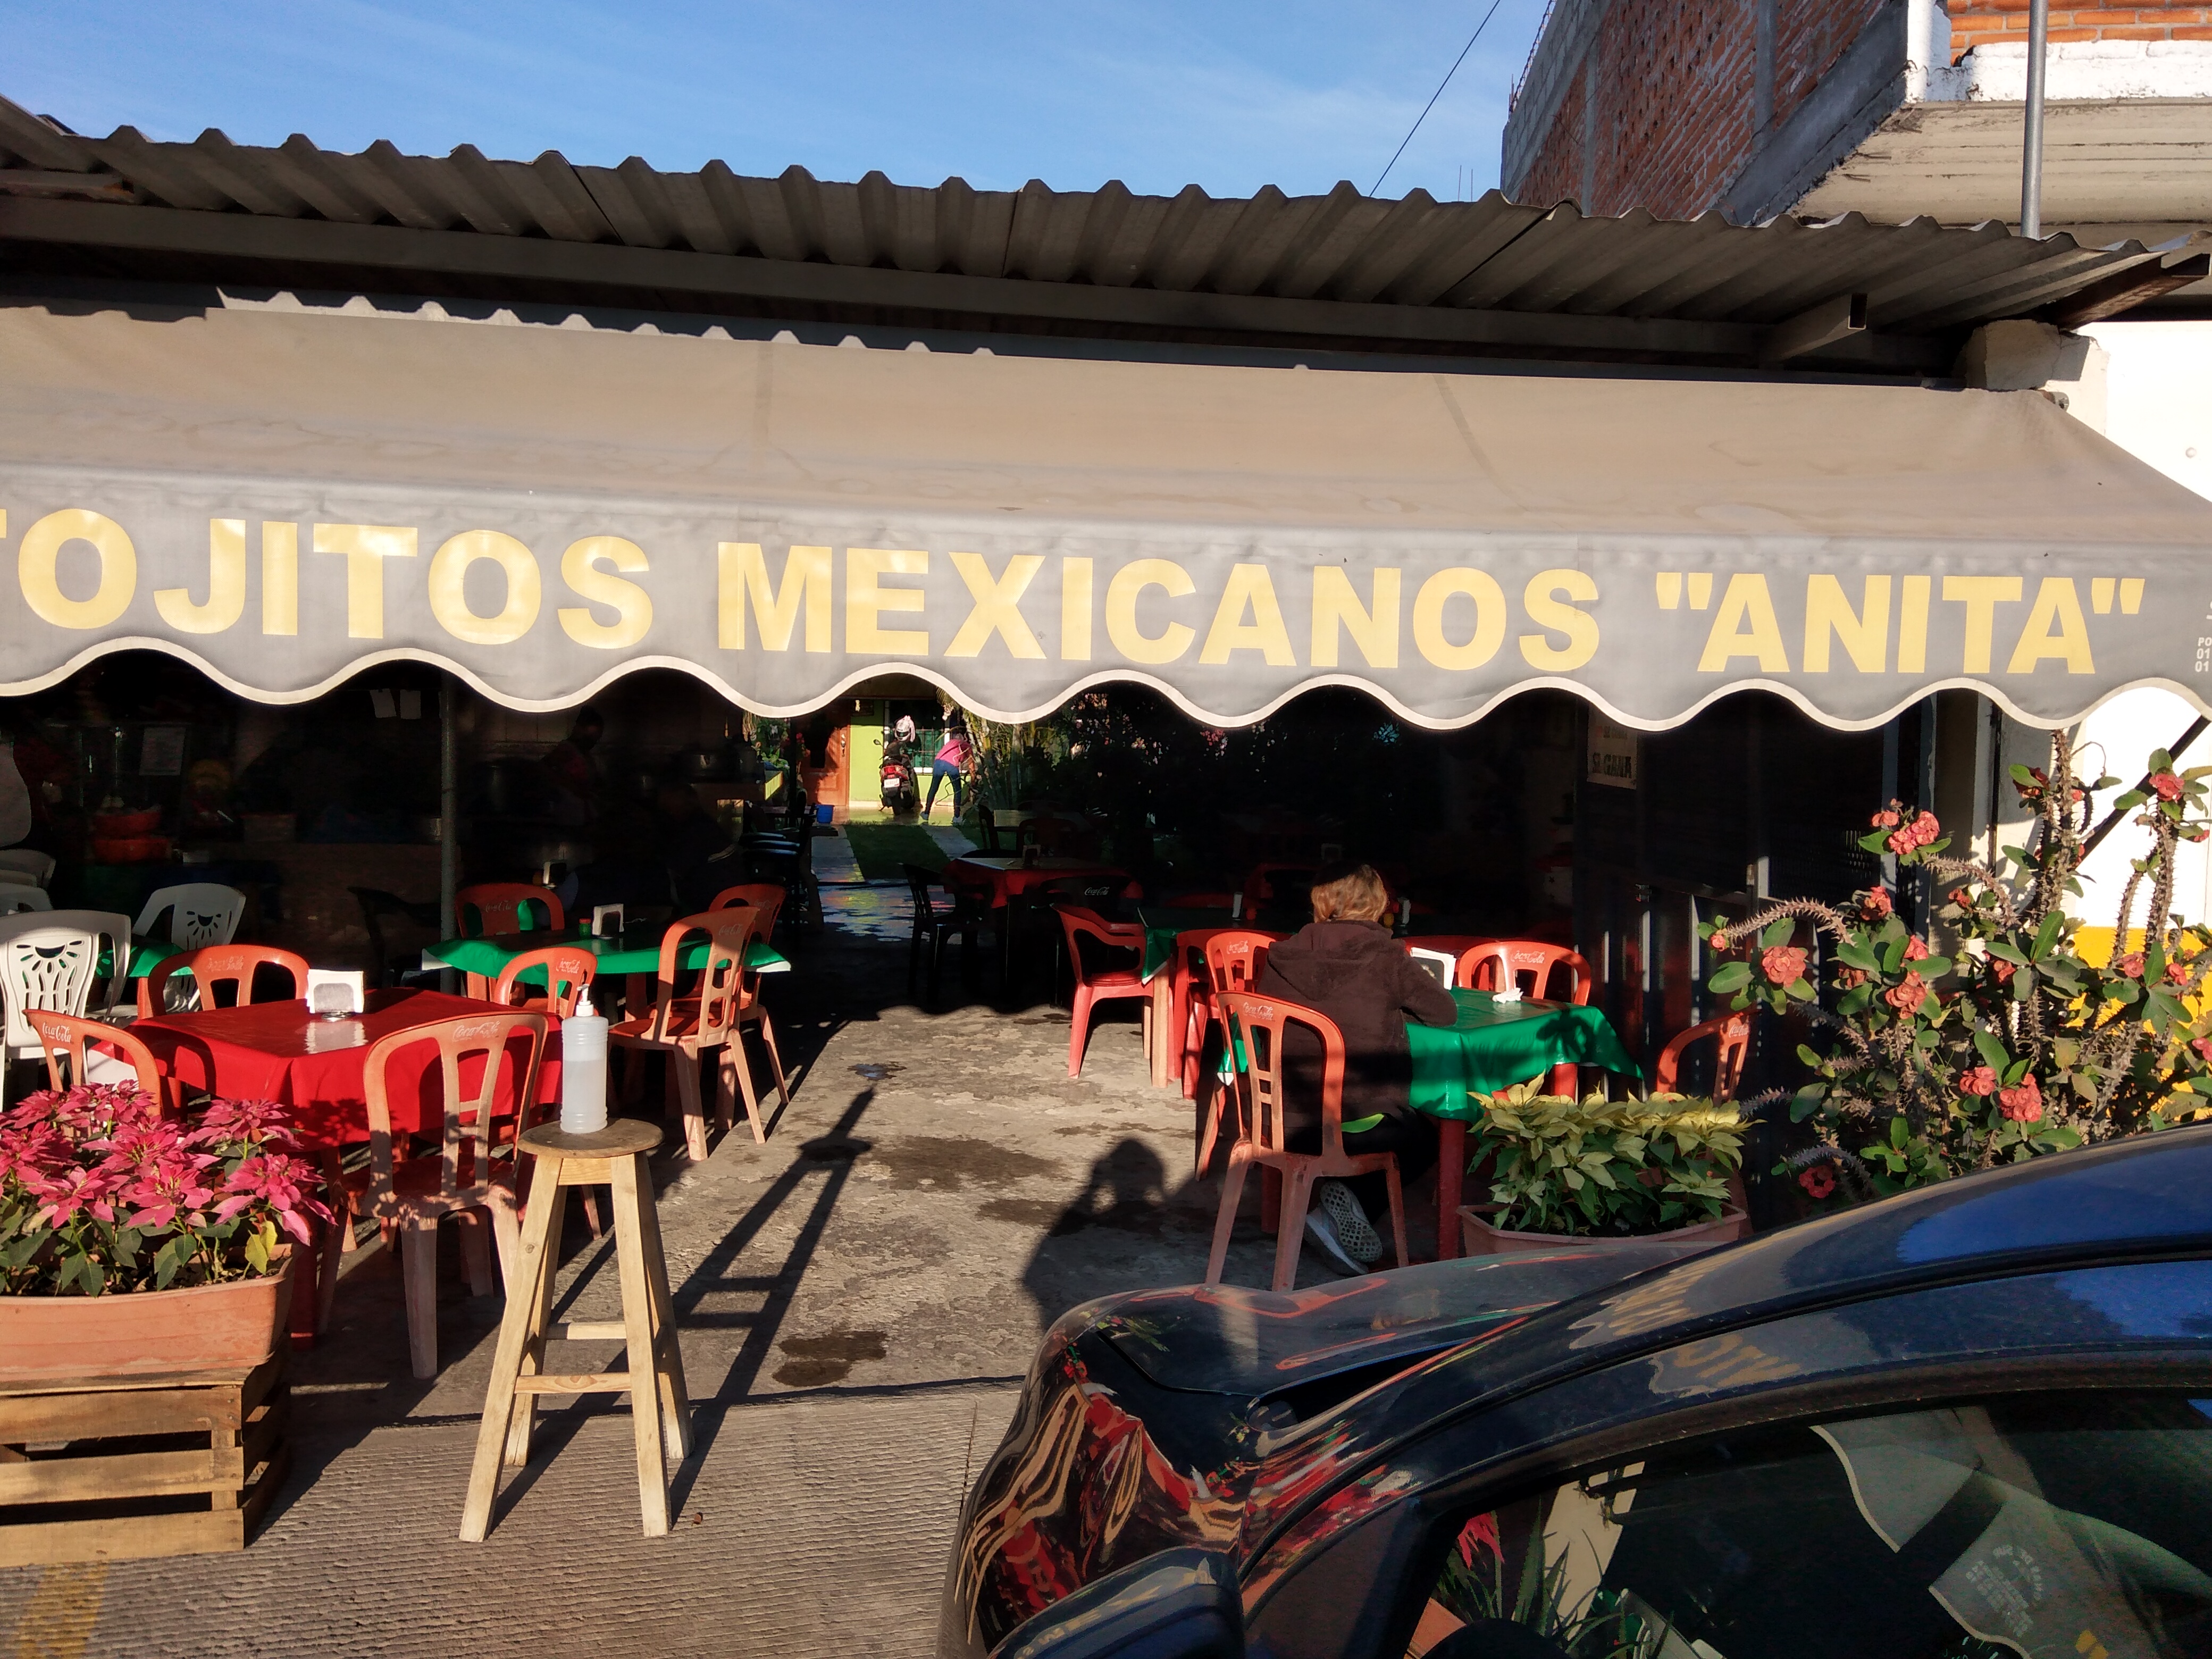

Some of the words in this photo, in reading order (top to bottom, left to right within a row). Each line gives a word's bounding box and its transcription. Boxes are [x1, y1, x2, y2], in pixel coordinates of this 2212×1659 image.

[0, 508, 653, 649] OJITOS
[716, 541, 1601, 673] MEXICANOS
[1655, 572, 2146, 675] "ANITA"
